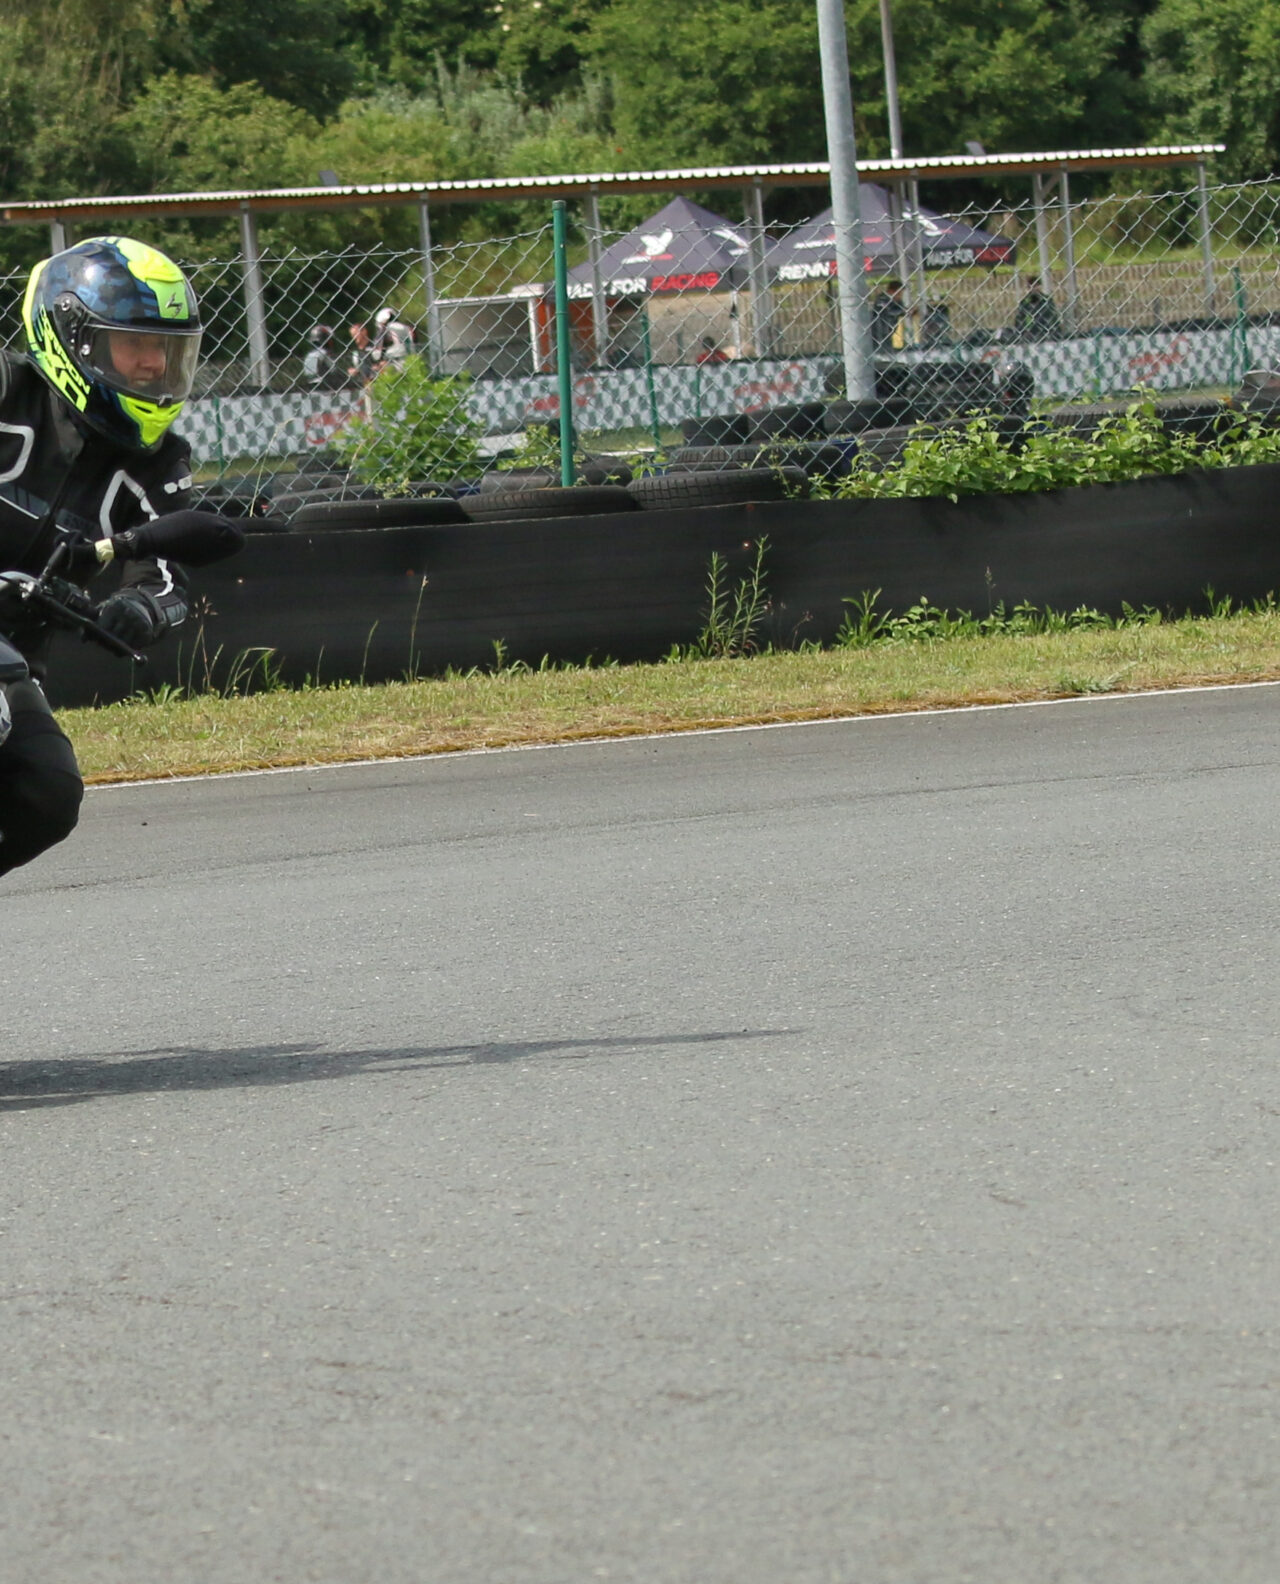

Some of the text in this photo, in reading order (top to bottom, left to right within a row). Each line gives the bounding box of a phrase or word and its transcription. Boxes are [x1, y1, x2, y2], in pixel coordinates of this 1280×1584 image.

[610, 278, 647, 296] FOR
[651, 272, 719, 291] RACING
[39, 302, 90, 395] CORPION
